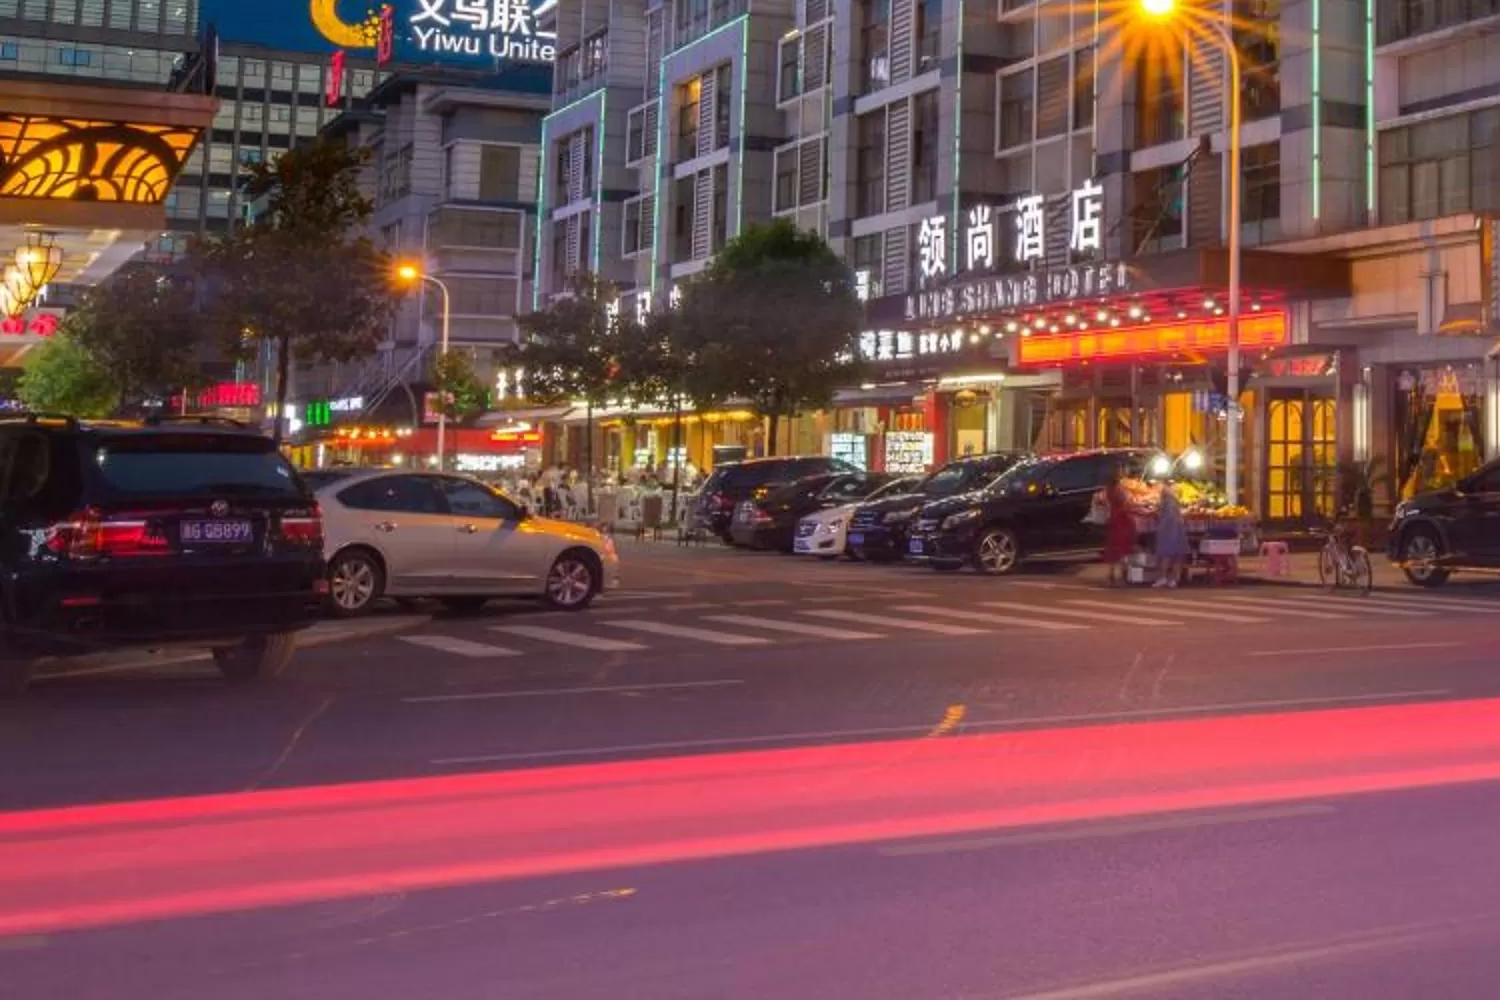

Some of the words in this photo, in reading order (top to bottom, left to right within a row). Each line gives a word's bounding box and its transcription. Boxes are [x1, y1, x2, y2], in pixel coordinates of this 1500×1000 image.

[413, 25, 479, 55] Yiwu
[918, 178, 1103, 277] 领尚酒店
